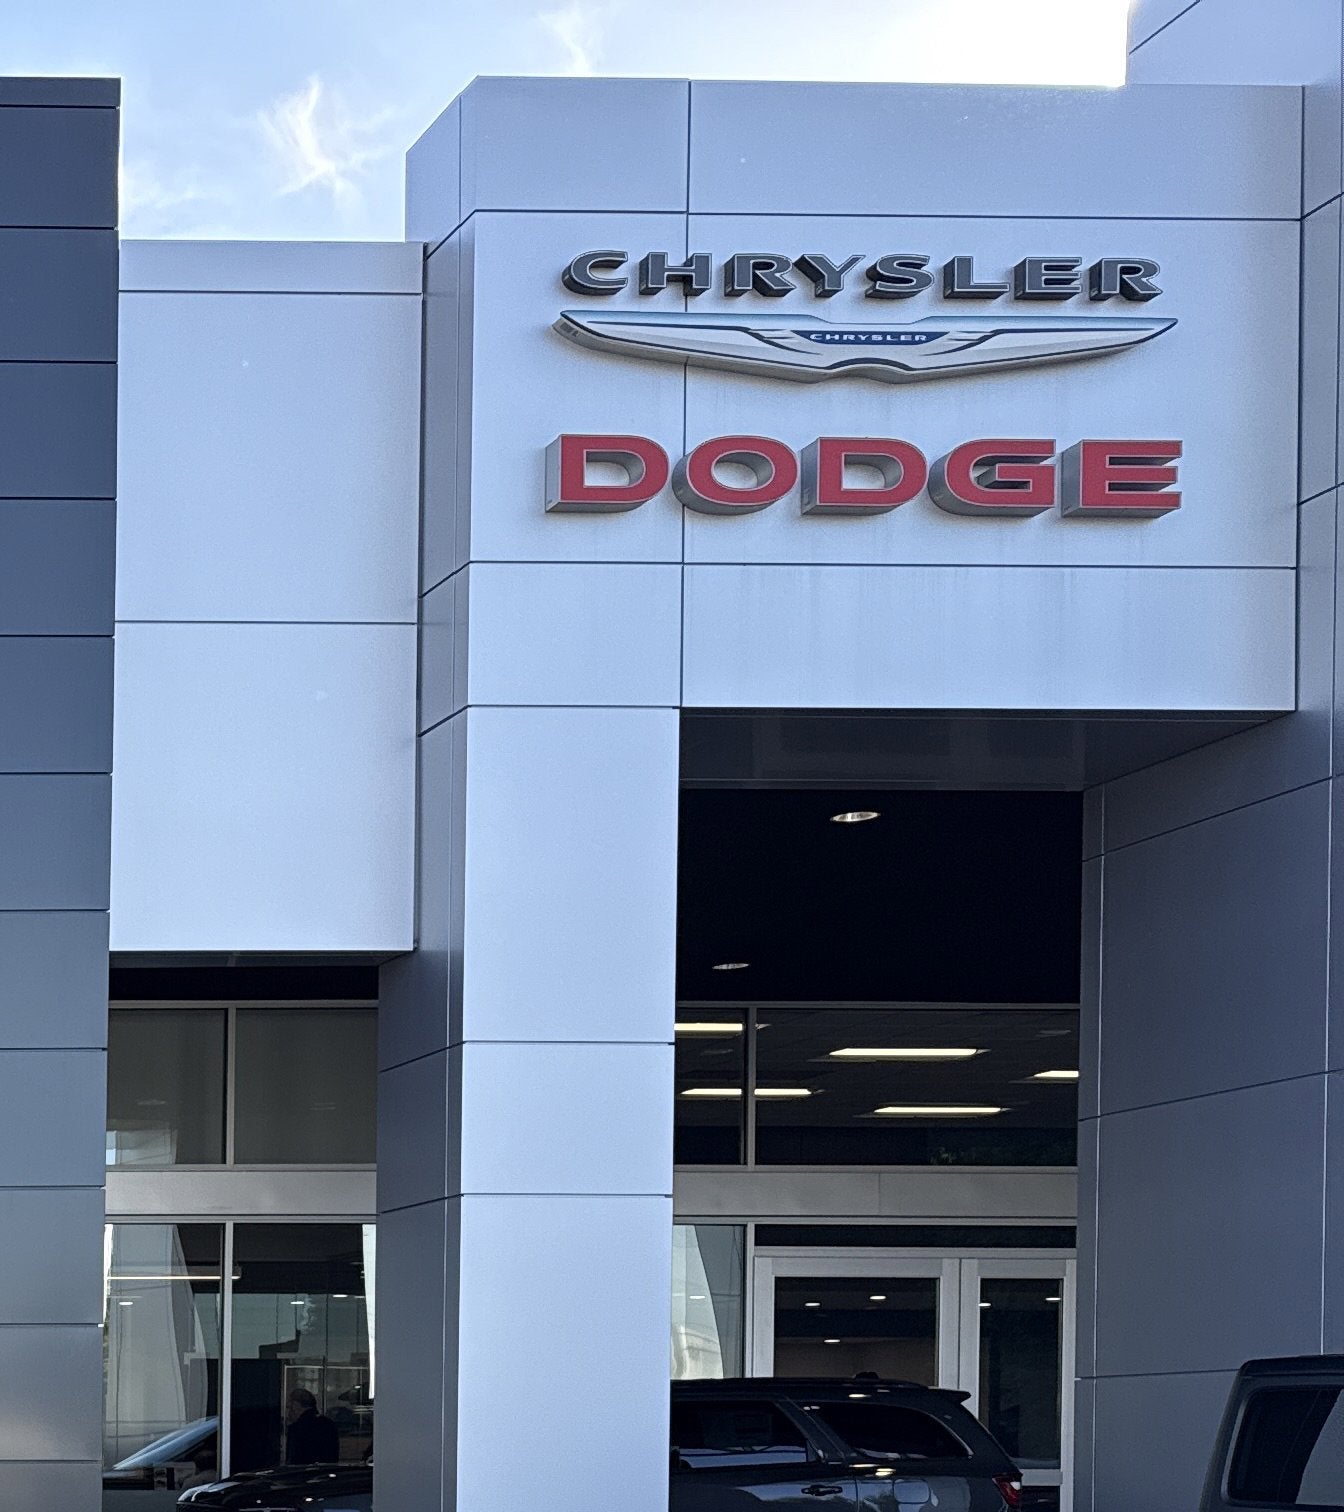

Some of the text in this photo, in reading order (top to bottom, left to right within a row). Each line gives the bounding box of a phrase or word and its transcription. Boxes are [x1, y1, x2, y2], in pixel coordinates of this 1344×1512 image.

[561, 249, 1162, 302] CHRYSLER
[810, 333, 927, 342] CHRYSLER
[545, 433, 1183, 518] DODGE
